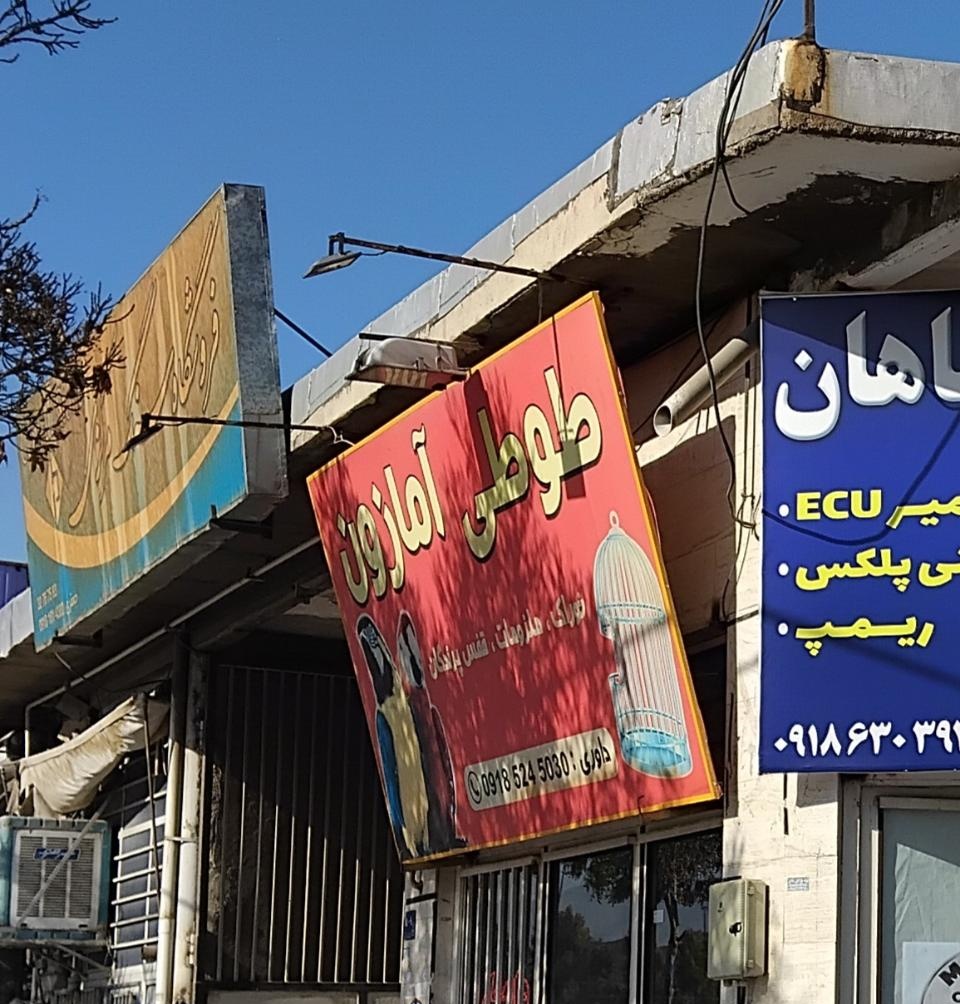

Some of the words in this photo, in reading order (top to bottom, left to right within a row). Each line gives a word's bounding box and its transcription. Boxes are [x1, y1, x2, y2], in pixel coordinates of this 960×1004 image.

[462, 366, 602, 560] طوطی
[336, 423, 446, 606] آمازون
[796, 489, 882, 521] ECU
[795, 547, 912, 592] پلکس
[795, 616, 934, 656] ریمپ
[511, 761, 537, 790] 524
[537, 751, 570, 783] 5030
